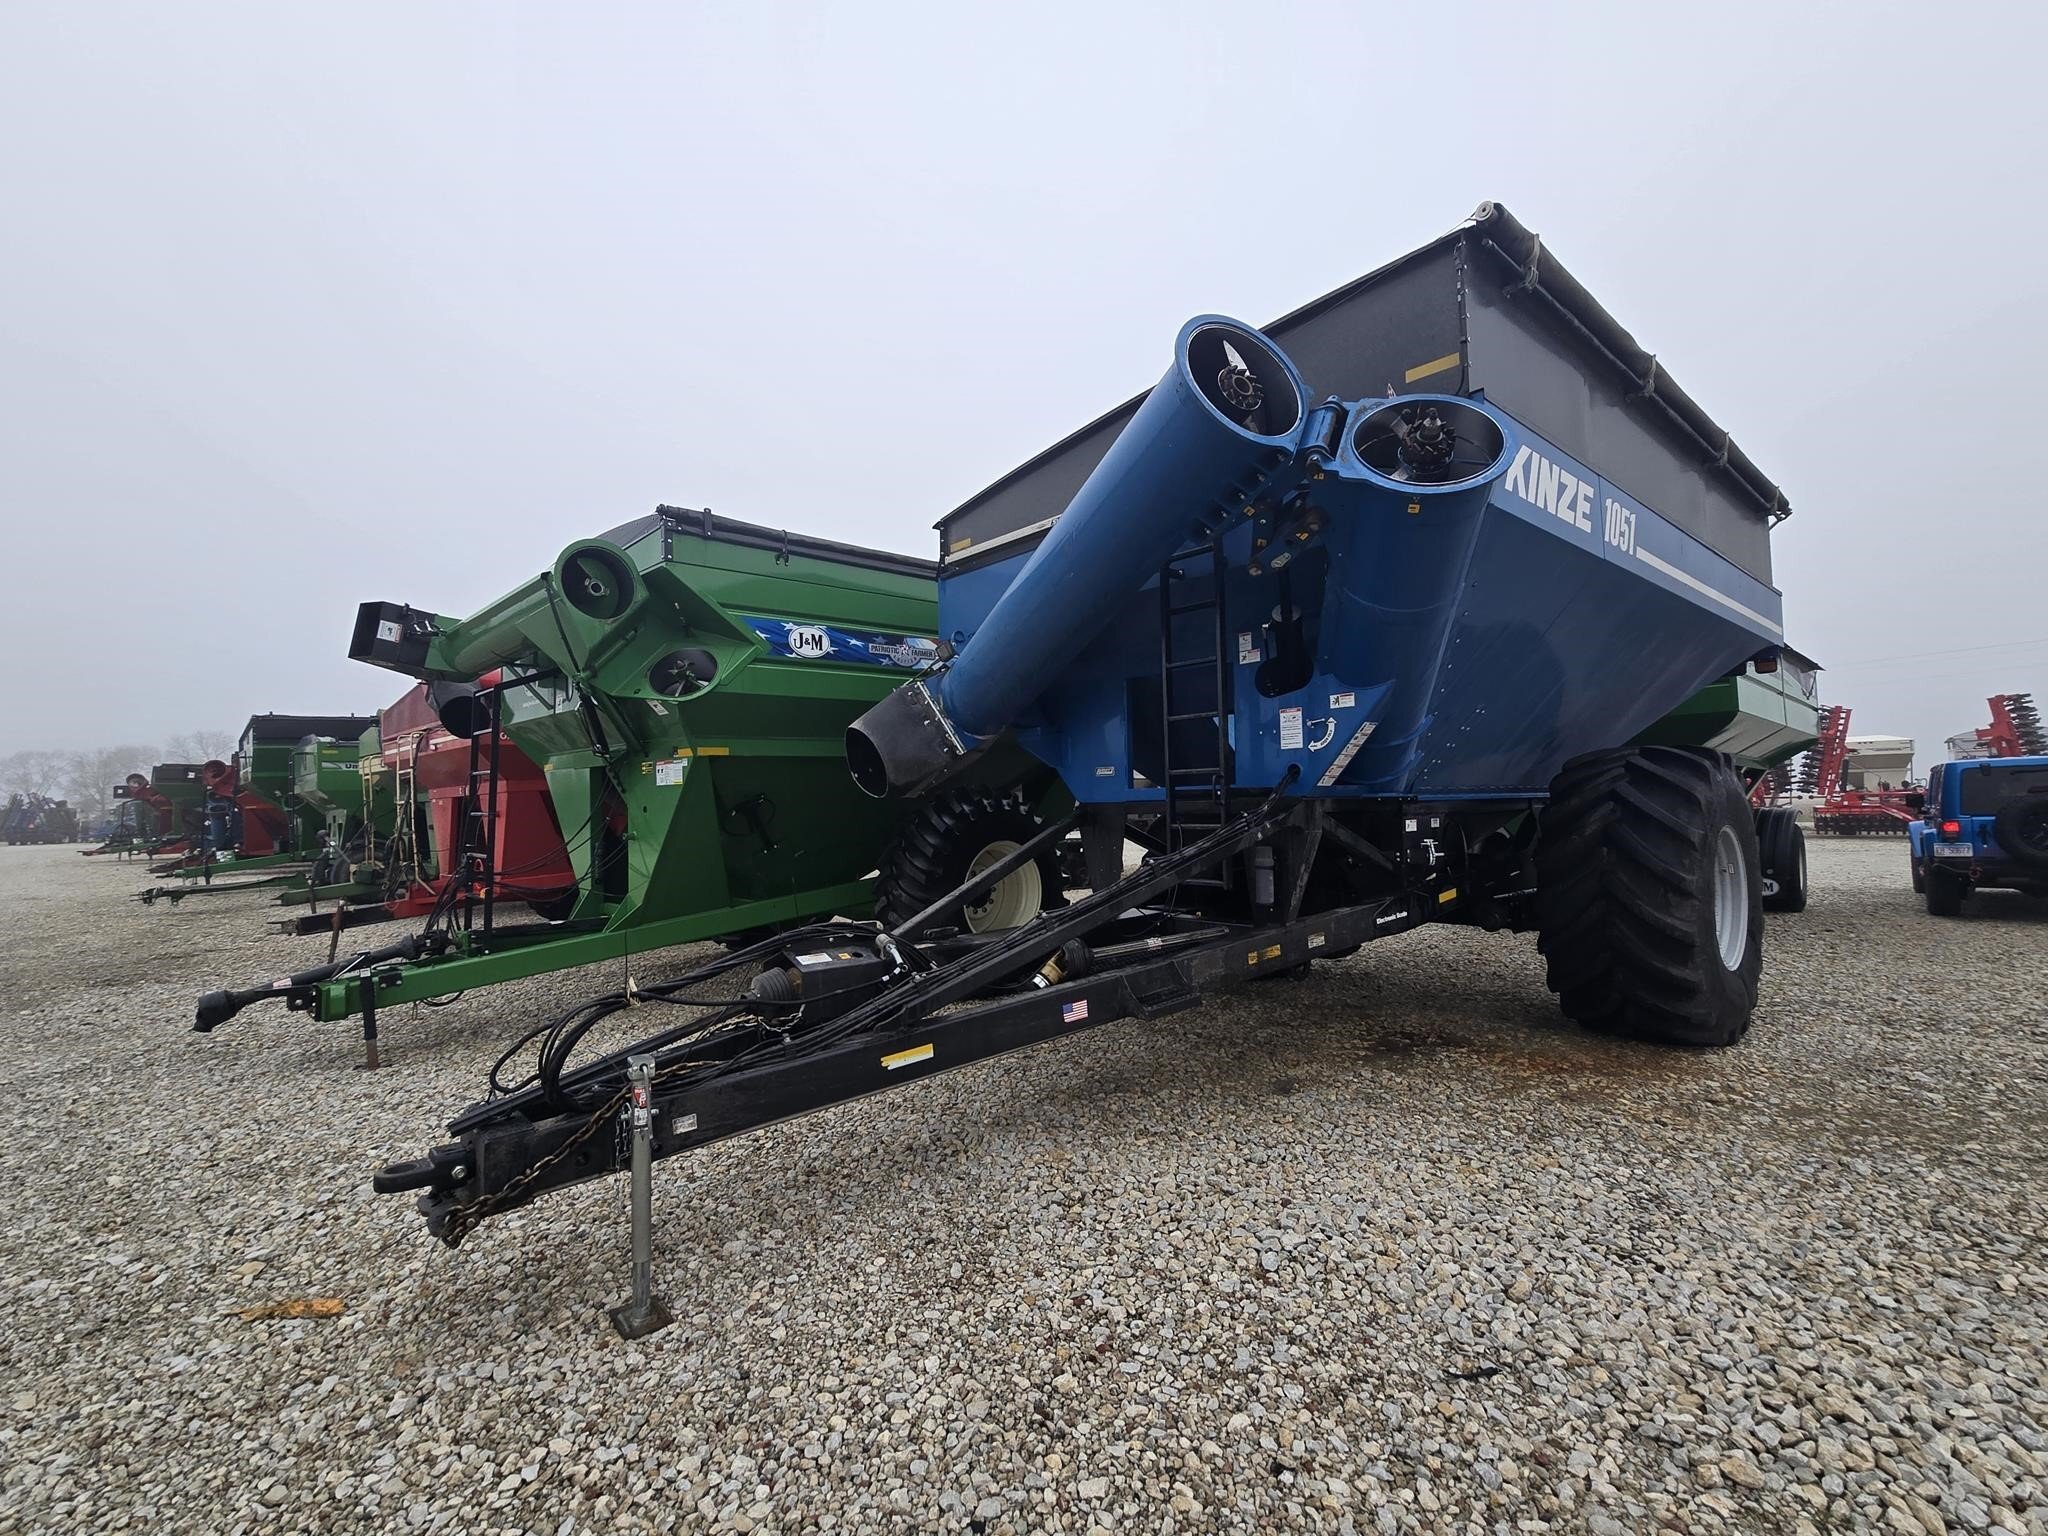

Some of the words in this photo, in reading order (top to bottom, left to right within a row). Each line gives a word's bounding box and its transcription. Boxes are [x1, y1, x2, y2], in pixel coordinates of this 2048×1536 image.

[1504, 444, 1594, 533] KINZE
[1604, 498, 1637, 556] 1051
[793, 631, 823, 652] J&M
[870, 644, 900, 655] PATRIOTIC
[911, 649, 933, 658] FARMER
